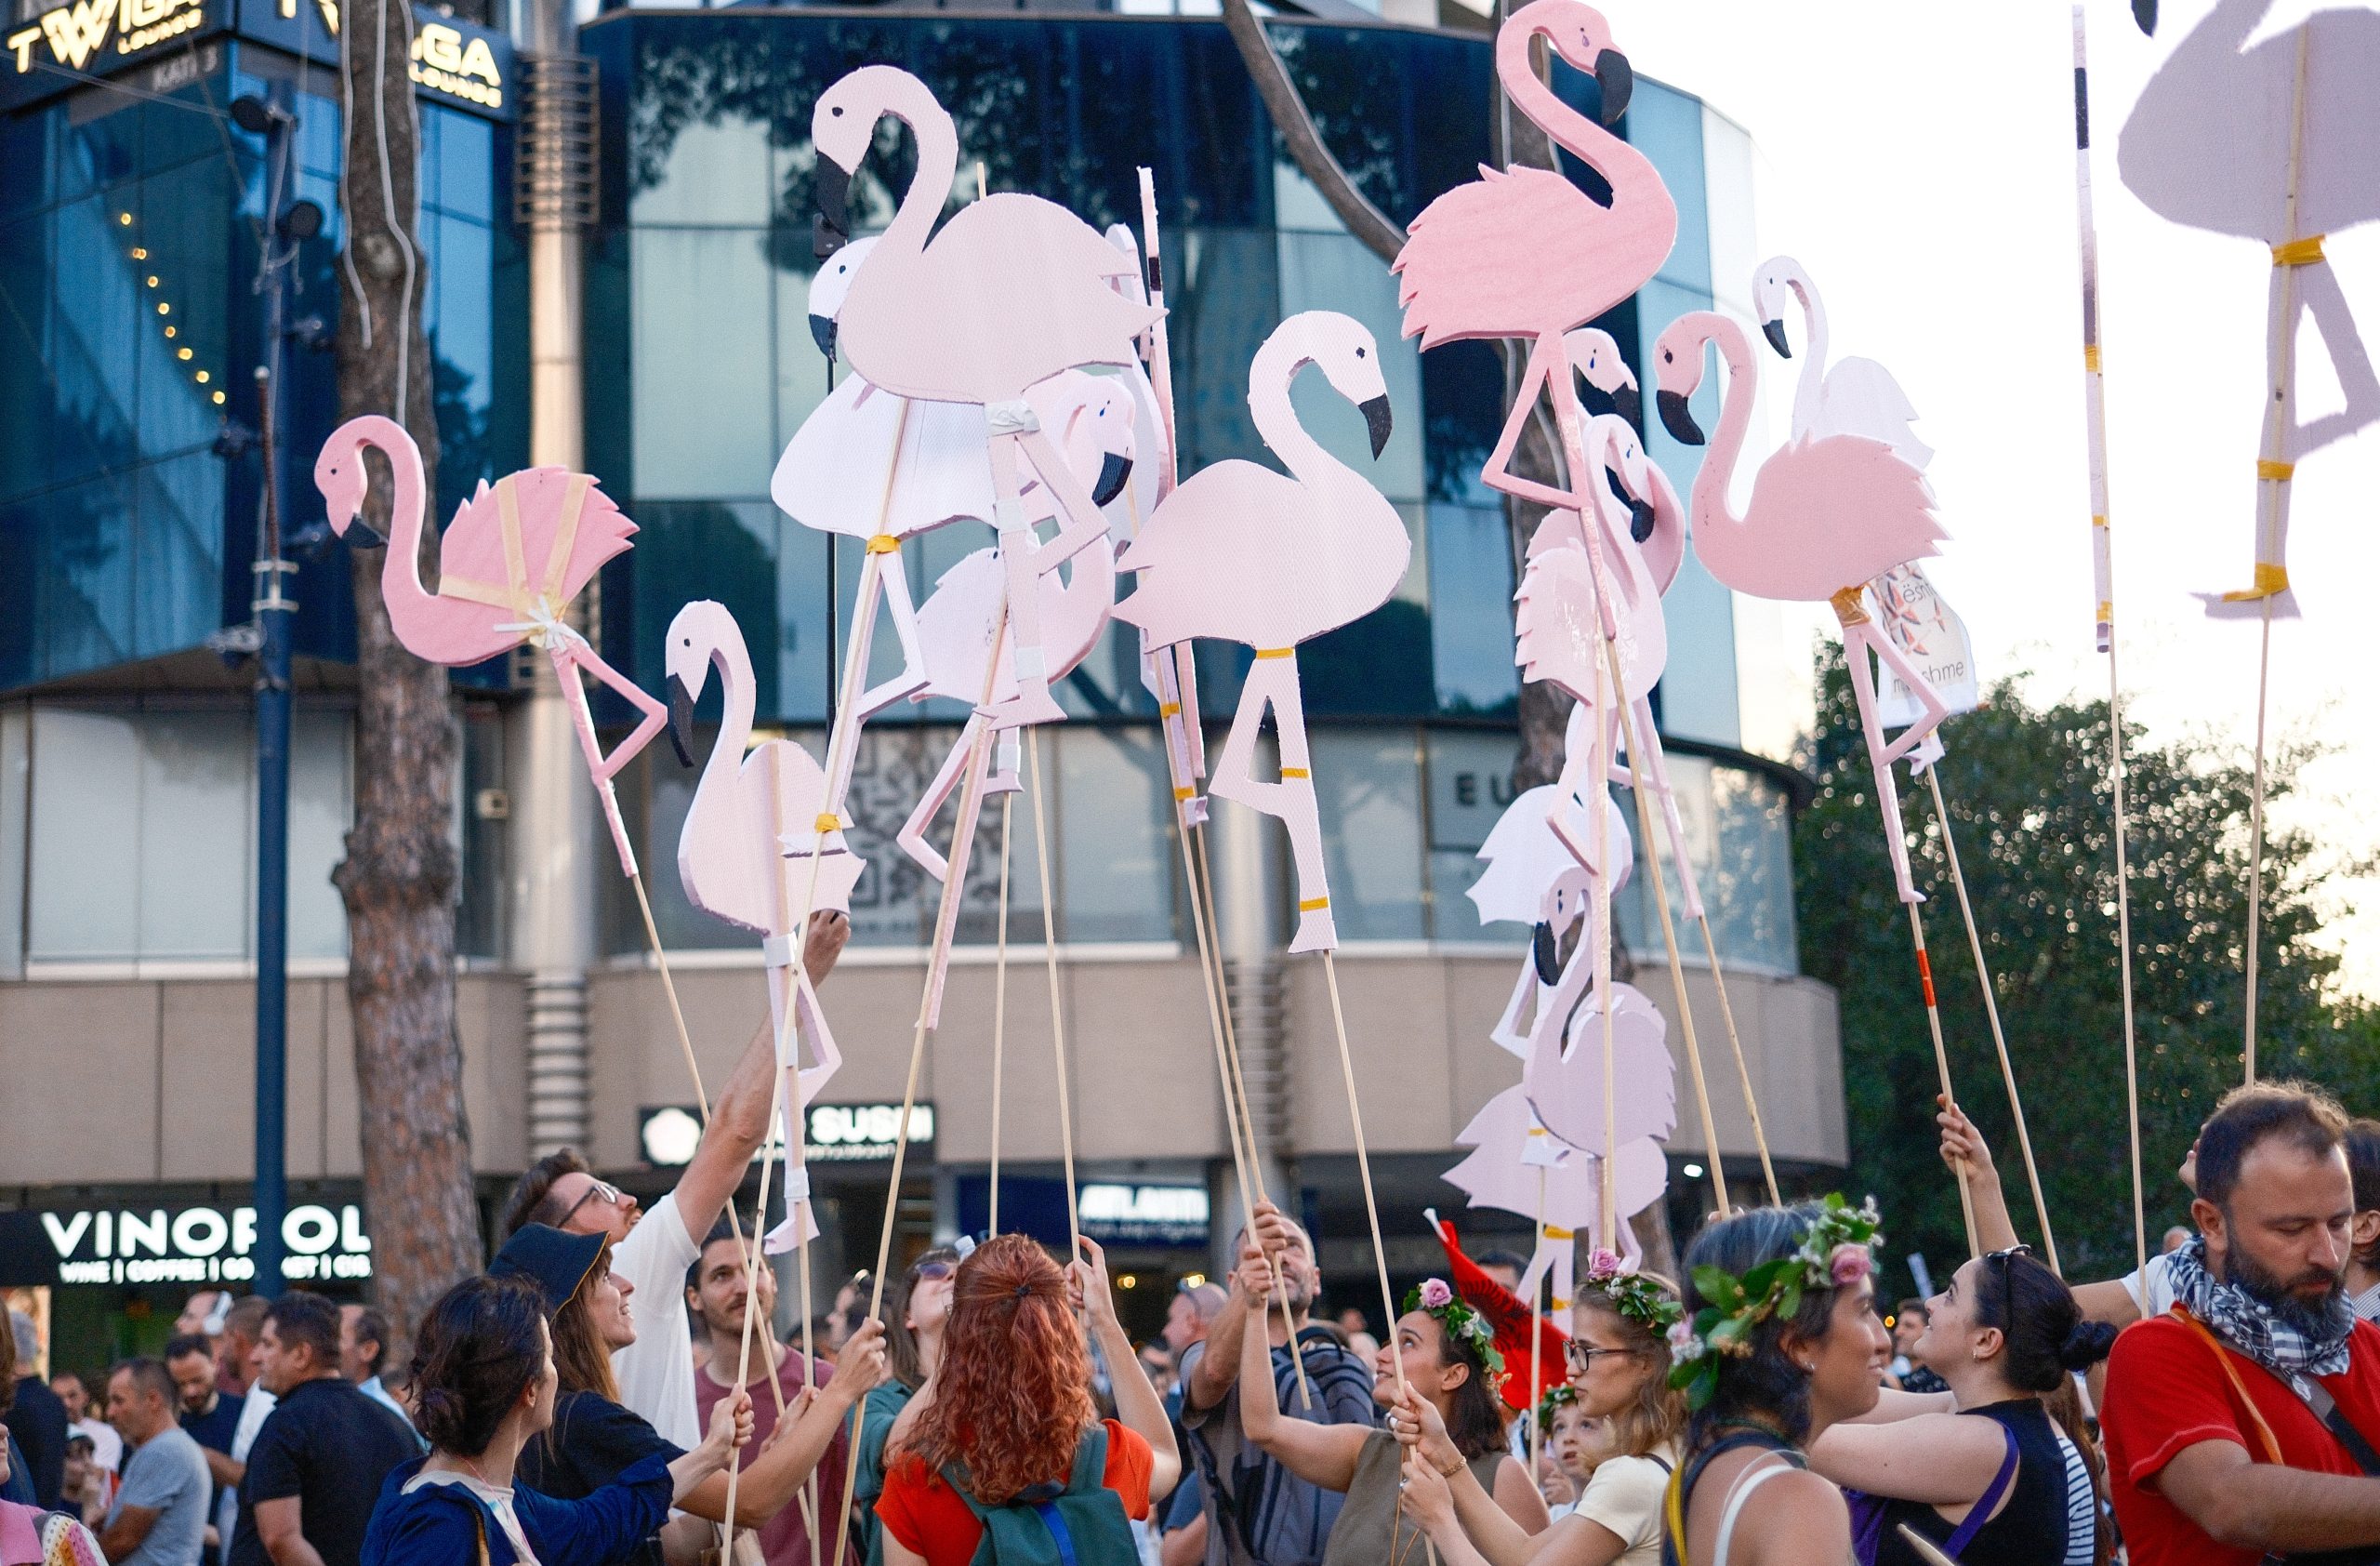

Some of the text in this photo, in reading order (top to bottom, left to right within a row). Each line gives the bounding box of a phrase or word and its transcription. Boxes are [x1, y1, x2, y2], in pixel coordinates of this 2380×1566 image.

[811, 1105, 934, 1145] SUSHI
[40, 1205, 372, 1257] VINOPOL
[126, 1257, 207, 1282] COFFEE
